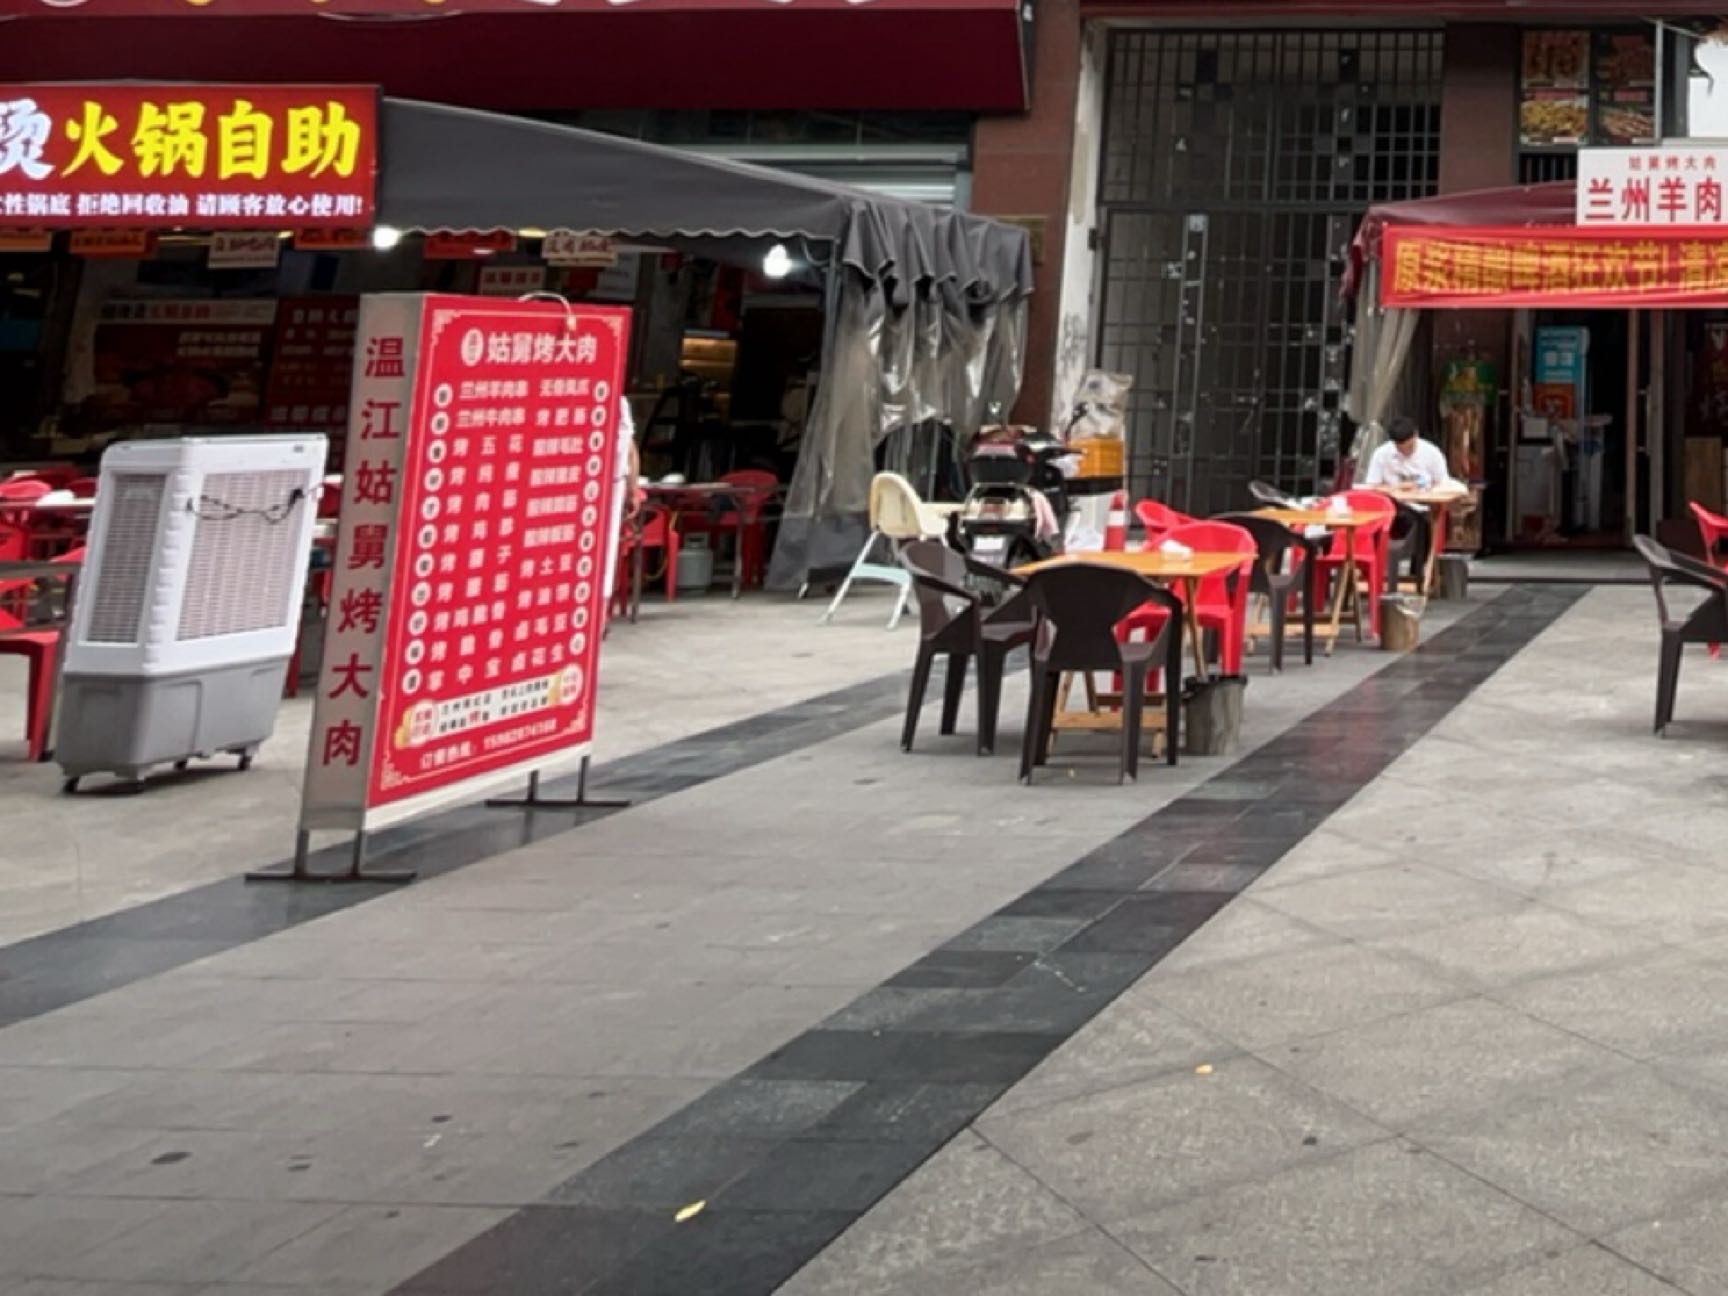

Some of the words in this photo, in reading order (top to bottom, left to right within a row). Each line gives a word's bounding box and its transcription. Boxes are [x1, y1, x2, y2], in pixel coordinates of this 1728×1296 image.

[1629, 155, 1717, 171] 姑舅烤大肉
[0, 192, 70, 216] 性锅底
[486, 332, 598, 364] 姑舅烤大肉
[322, 336, 405, 767] 温江姑舅烤大肉
